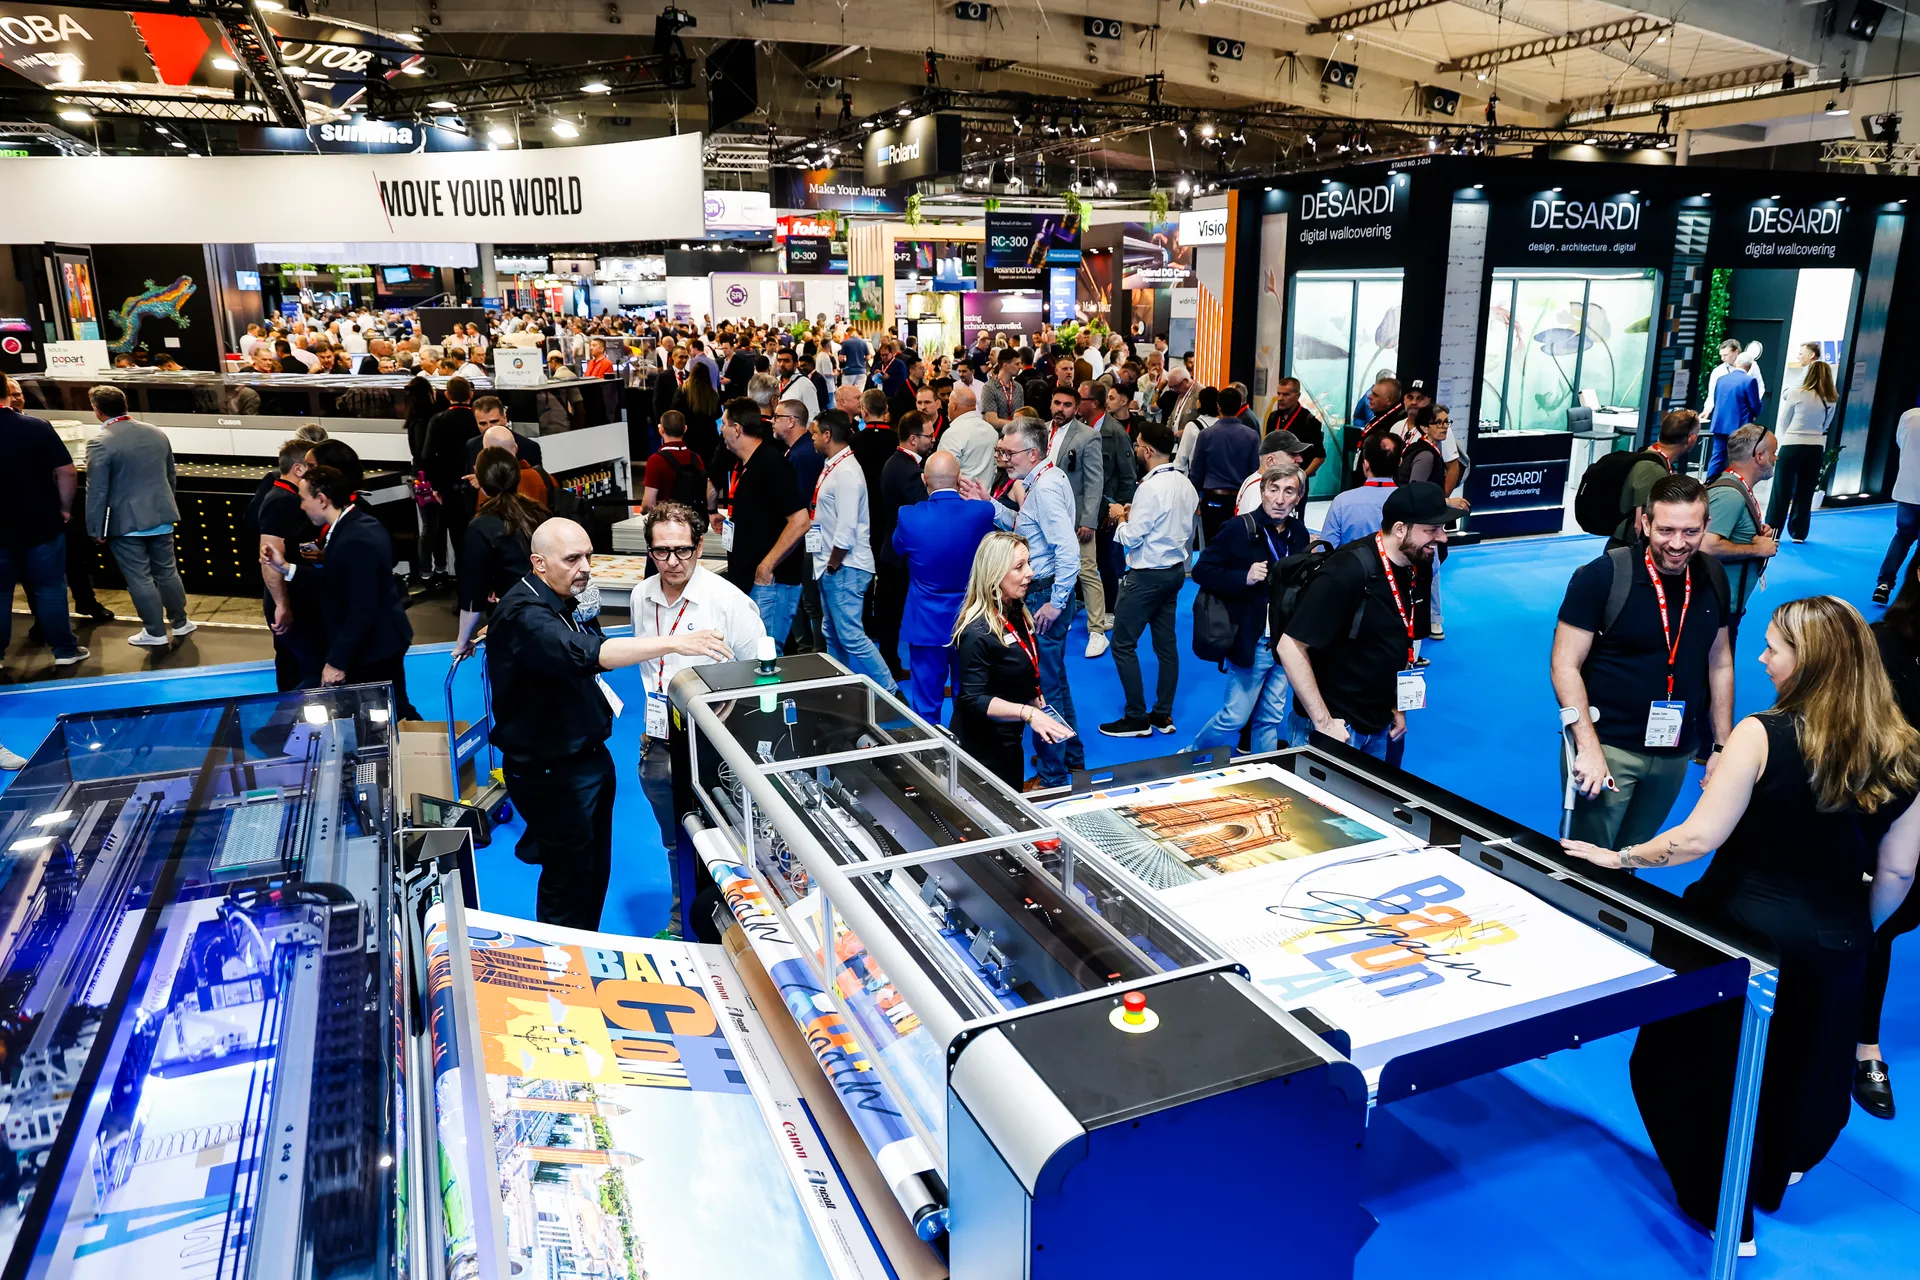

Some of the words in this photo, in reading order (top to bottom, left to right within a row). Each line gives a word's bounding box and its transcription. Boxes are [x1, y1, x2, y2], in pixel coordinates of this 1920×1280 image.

[888, 137, 919, 164] Roland
[1391, 161, 1407, 169] STAND
[380, 179, 443, 217] MOVE
[447, 179, 505, 217] YOUR
[509, 176, 583, 216] WORLD
[809, 183, 835, 195] Make
[837, 184, 860, 197] Your
[862, 185, 887, 197] Mark
[1301, 184, 1395, 220] DESARDI
[1530, 200, 1640, 230] DESARDI
[1747, 207, 1842, 234] DESARDI
[991, 236, 1028, 247] RC-300
[1300, 228, 1328, 245] digital
[1329, 224, 1392, 240] wallcovering
[1528, 242, 1555, 253] design
[1561, 242, 1608, 253] architecture
[1613, 243, 1636, 254] digital
[1745, 242, 1774, 257] digital
[1777, 243, 1836, 258] wallcovering
[1137, 268, 1161, 277] Roland
[1162, 268, 1173, 277] DG
[1174, 268, 1190, 277] Care
[1083, 301, 1097, 312] Make
[964, 323, 996, 331] echnology,
[52, 355, 84, 364] popart
[217, 418, 242, 426] Canon
[1491, 471, 1542, 487] DESARDI
[1490, 489, 1506, 498] digital
[1507, 487, 1541, 496] wallcovering
[711, 975, 729, 1000] Canon
[782, 1121, 808, 1158] Canon
